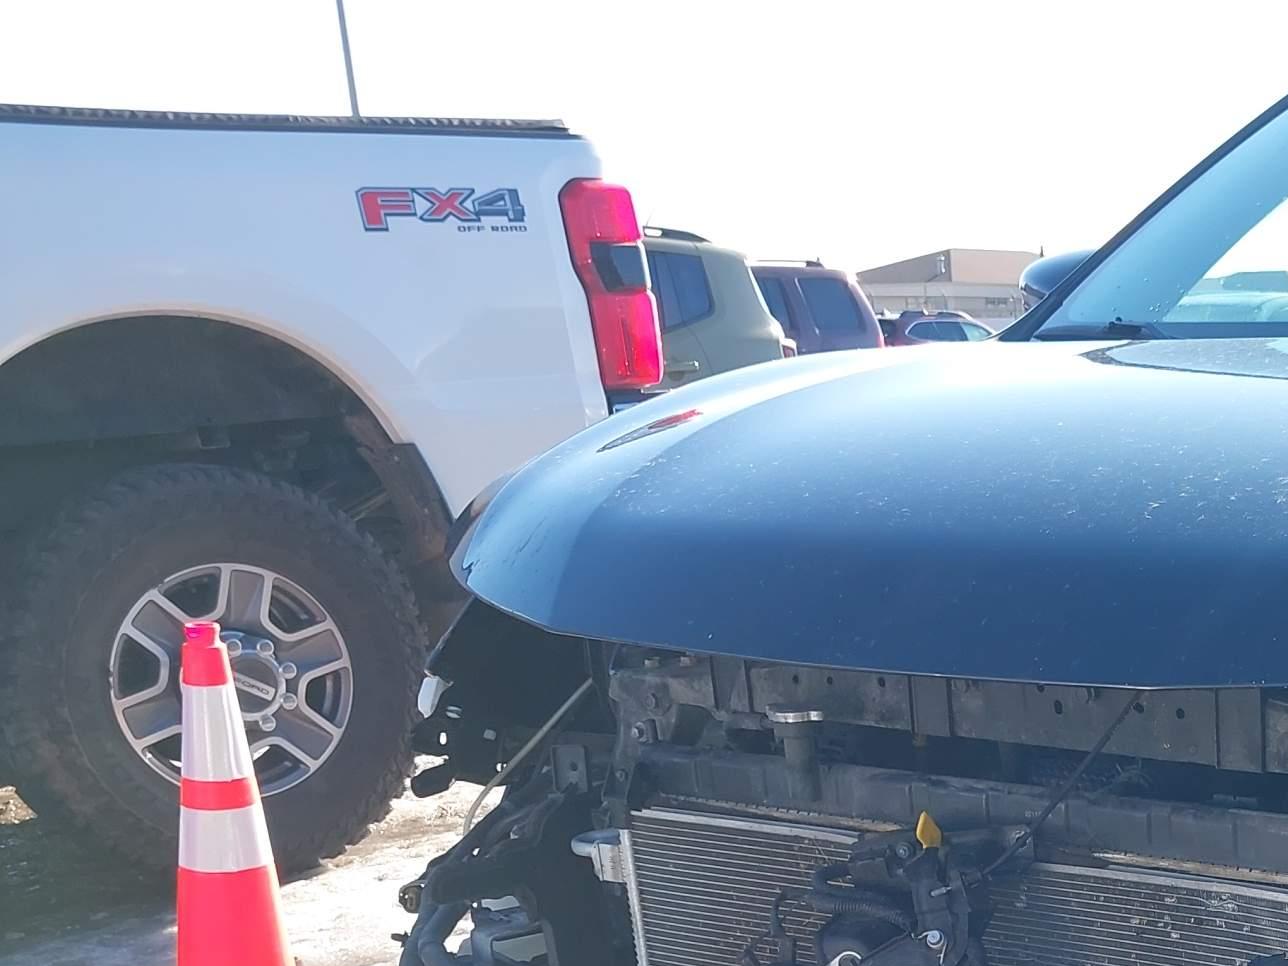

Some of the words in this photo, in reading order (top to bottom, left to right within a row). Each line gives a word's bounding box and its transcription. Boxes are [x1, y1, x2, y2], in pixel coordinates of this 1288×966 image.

[355, 186, 526, 232] FX4
[457, 225, 486, 233] OFF
[490, 225, 528, 233] ROAD
[236, 678, 270, 696] ORD
